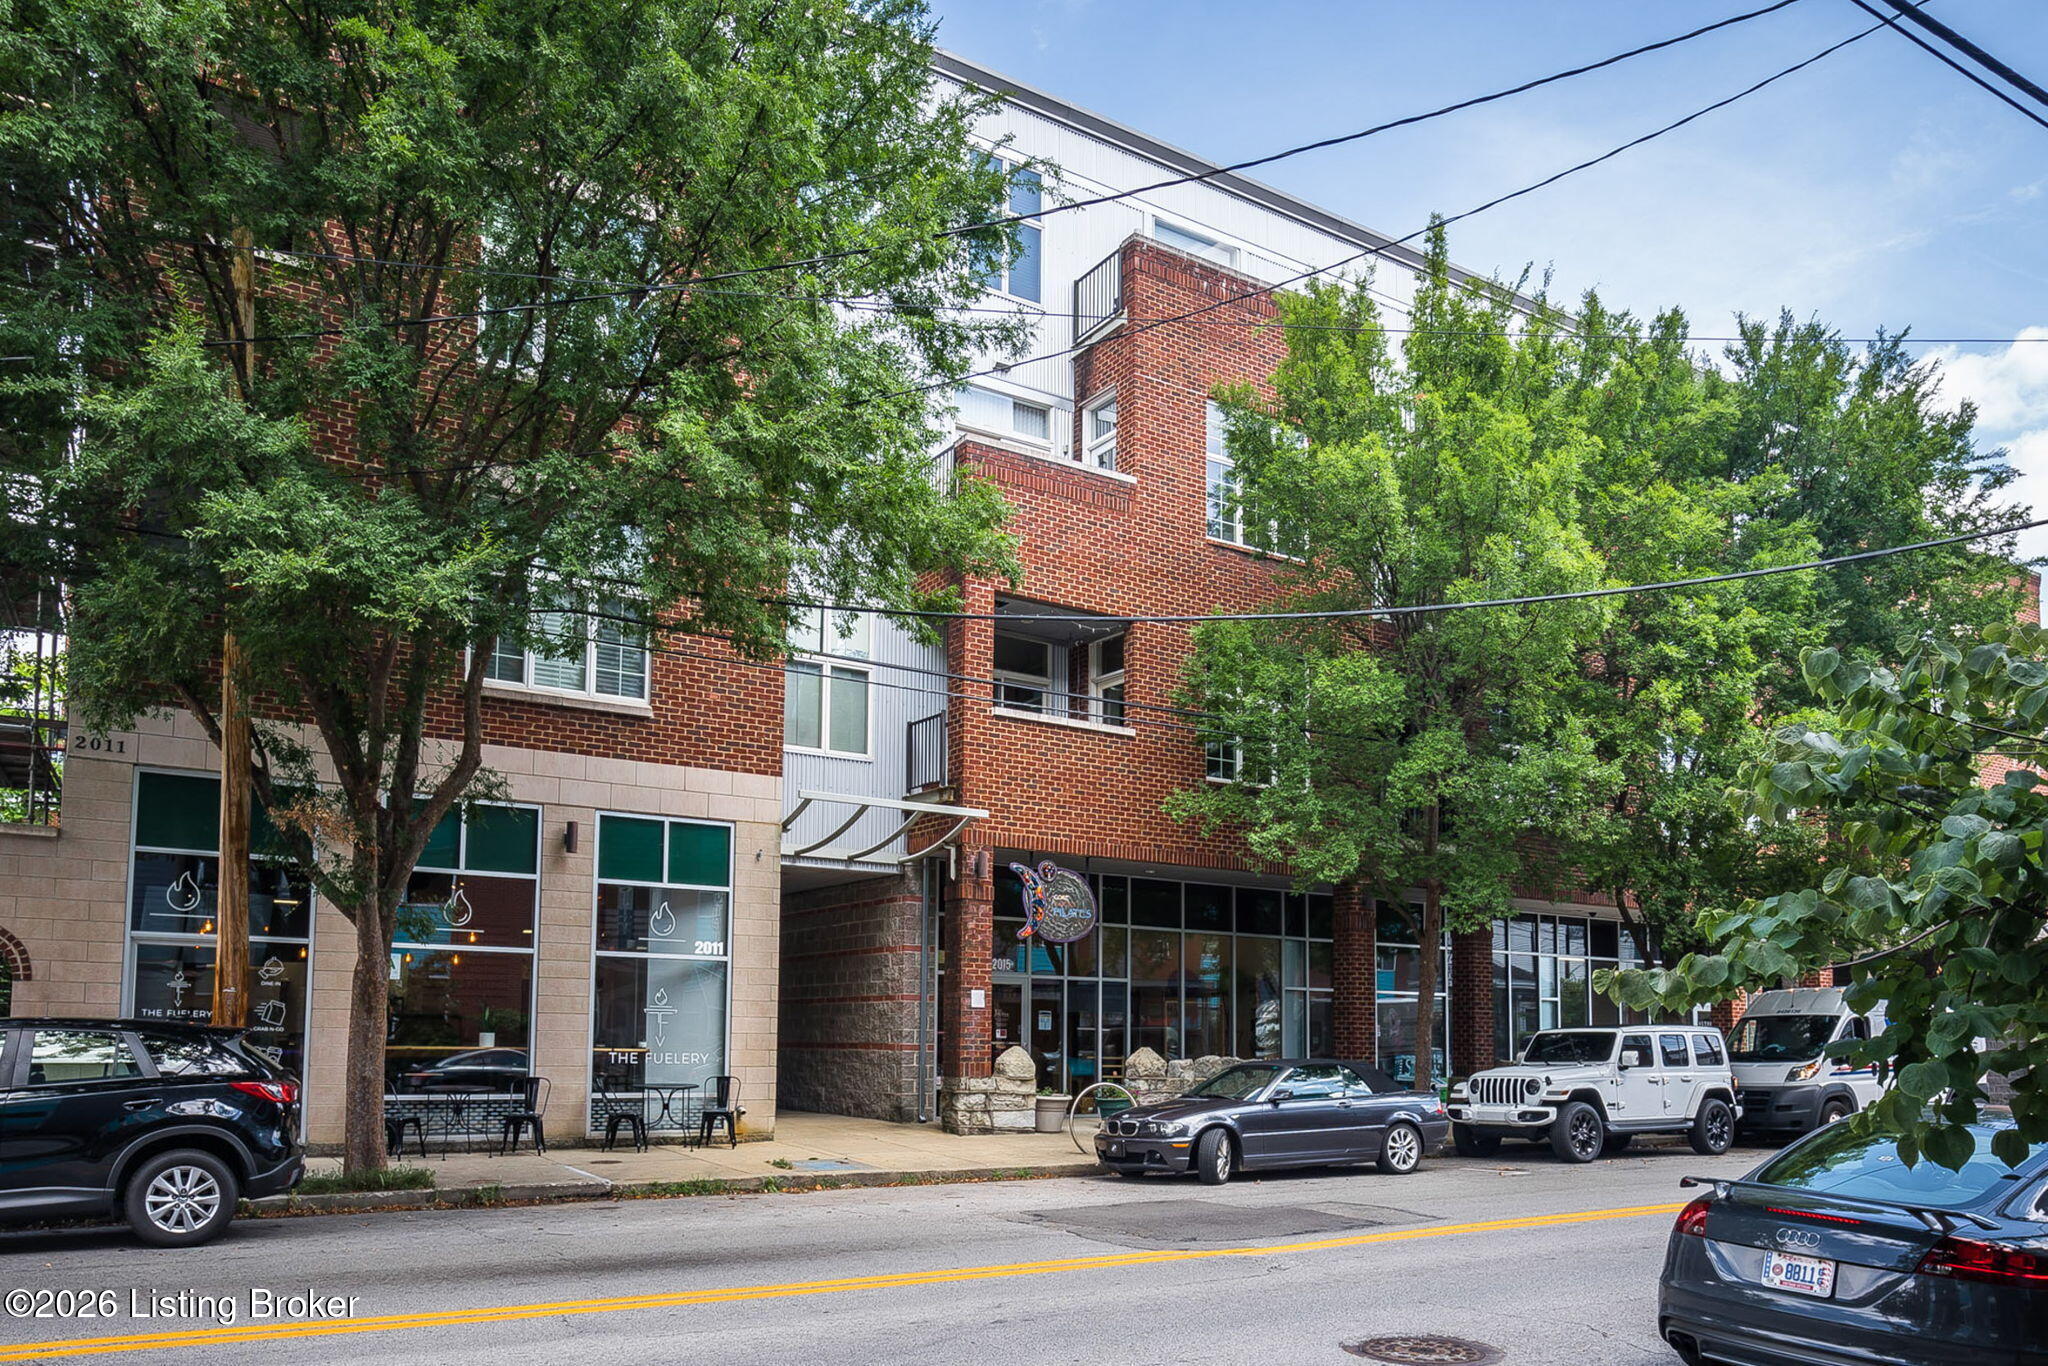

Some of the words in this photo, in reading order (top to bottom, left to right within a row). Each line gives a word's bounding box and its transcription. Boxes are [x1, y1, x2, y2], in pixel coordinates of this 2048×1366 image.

[75, 736, 126, 753] 2011
[694, 941, 724, 955] 2011
[992, 958, 1011, 970] 2015
[141, 1009, 163, 1017] THE
[608, 1052, 638, 1064] THE
[645, 1052, 710, 1065] FUELERY
[1785, 1262, 1816, 1285] 8811
